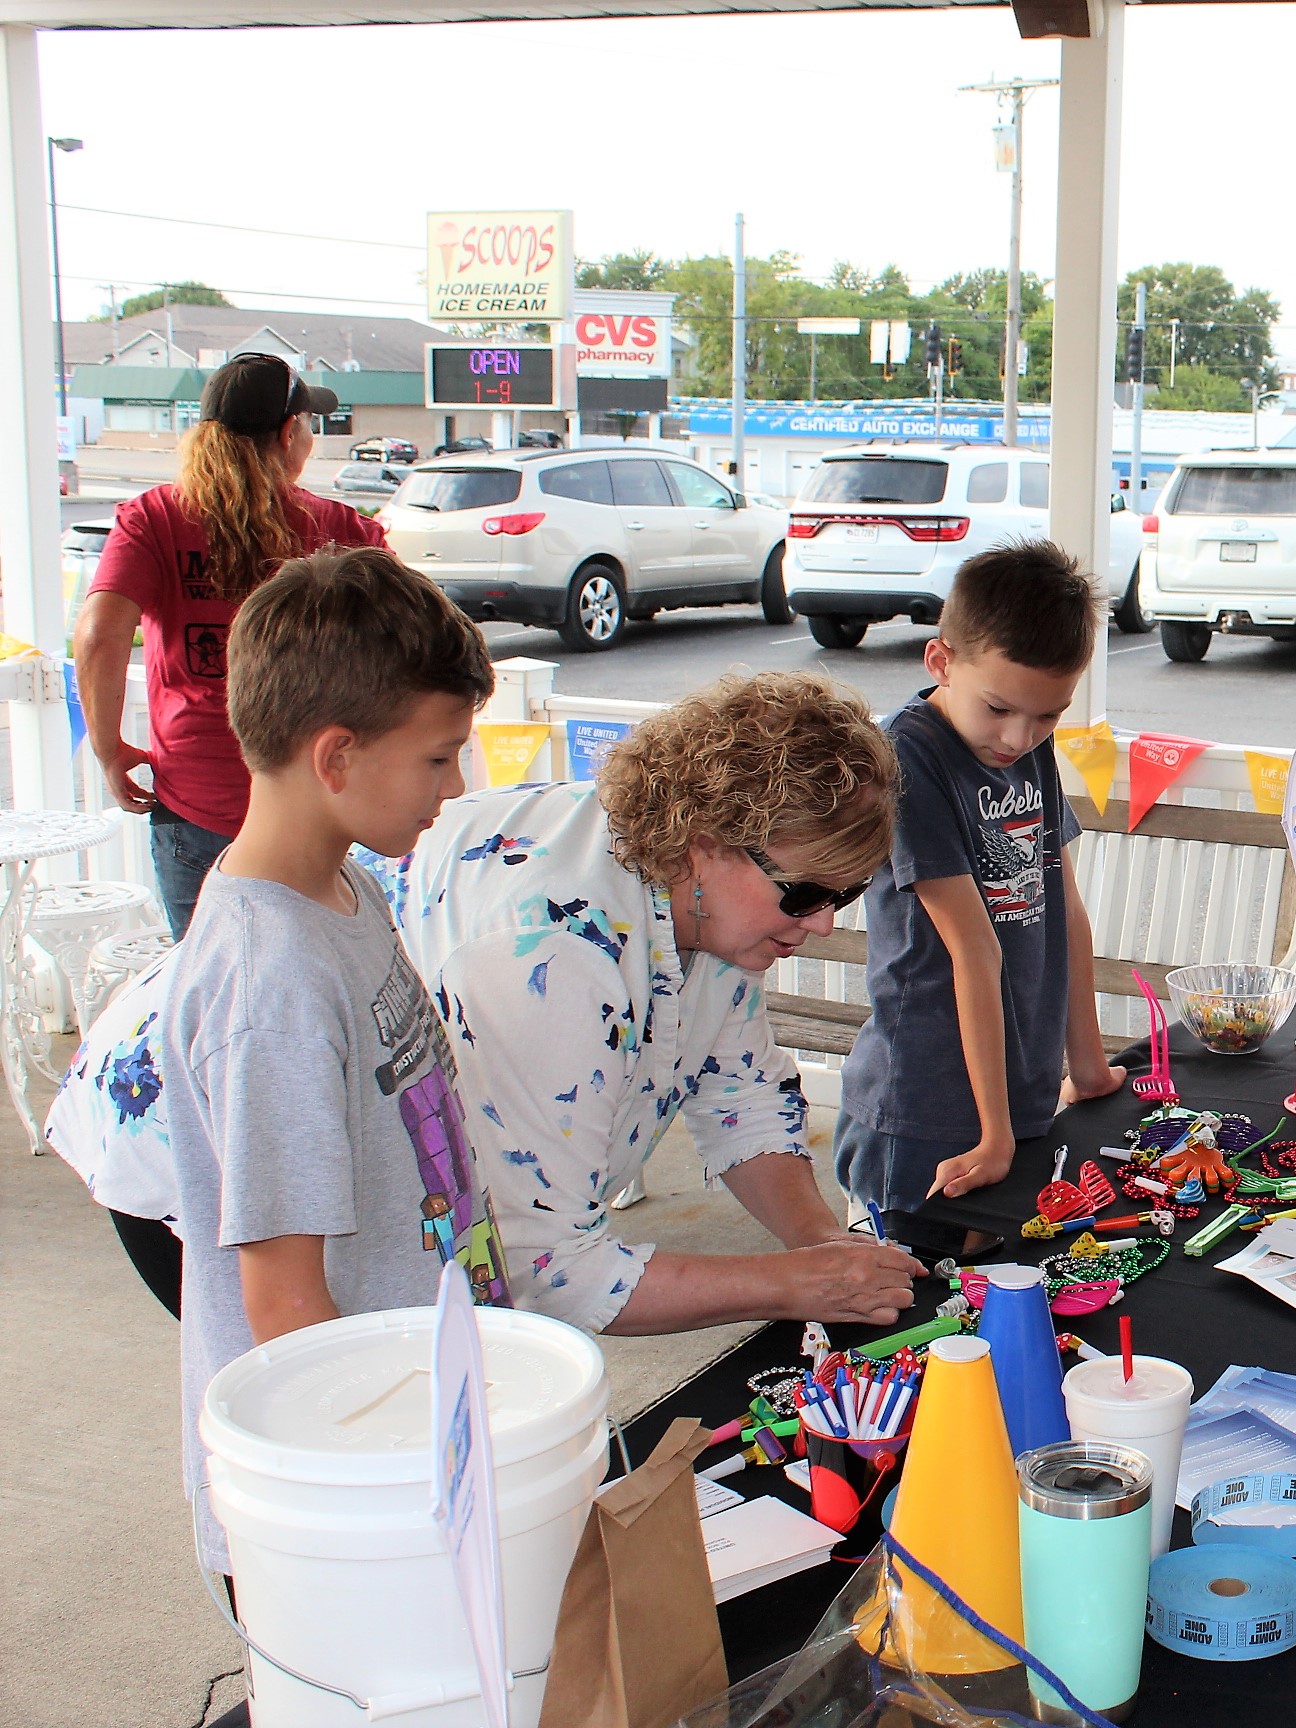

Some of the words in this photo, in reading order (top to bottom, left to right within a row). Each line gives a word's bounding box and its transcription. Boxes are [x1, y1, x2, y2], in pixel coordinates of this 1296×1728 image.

[437, 282, 550, 296] HOMEMADE
[439, 298, 471, 311] ICE
[477, 298, 547, 311] CREAM
[576, 314, 657, 346] CVS
[469, 350, 520, 375] OPEN
[577, 348, 655, 364] pharmacy
[473, 381, 512, 403] 1-9
[790, 418, 859, 433] CERTIFIED
[861, 421, 898, 435] AUTO
[902, 420, 979, 438] EXCHANGE
[577, 725, 593, 736] LIVE
[593, 727, 619, 740] UNITED
[1145, 749, 1161, 762] Way
[1260, 767, 1277, 778] LIVE
[1225, 1481, 1245, 1495] ONE
[1221, 1491, 1249, 1507] ADMIT
[1184, 1619, 1207, 1632] ONE
[1255, 1619, 1277, 1632] ONE
[1178, 1629, 1213, 1645] ADMIT
[1249, 1629, 1282, 1646] ADMIT
